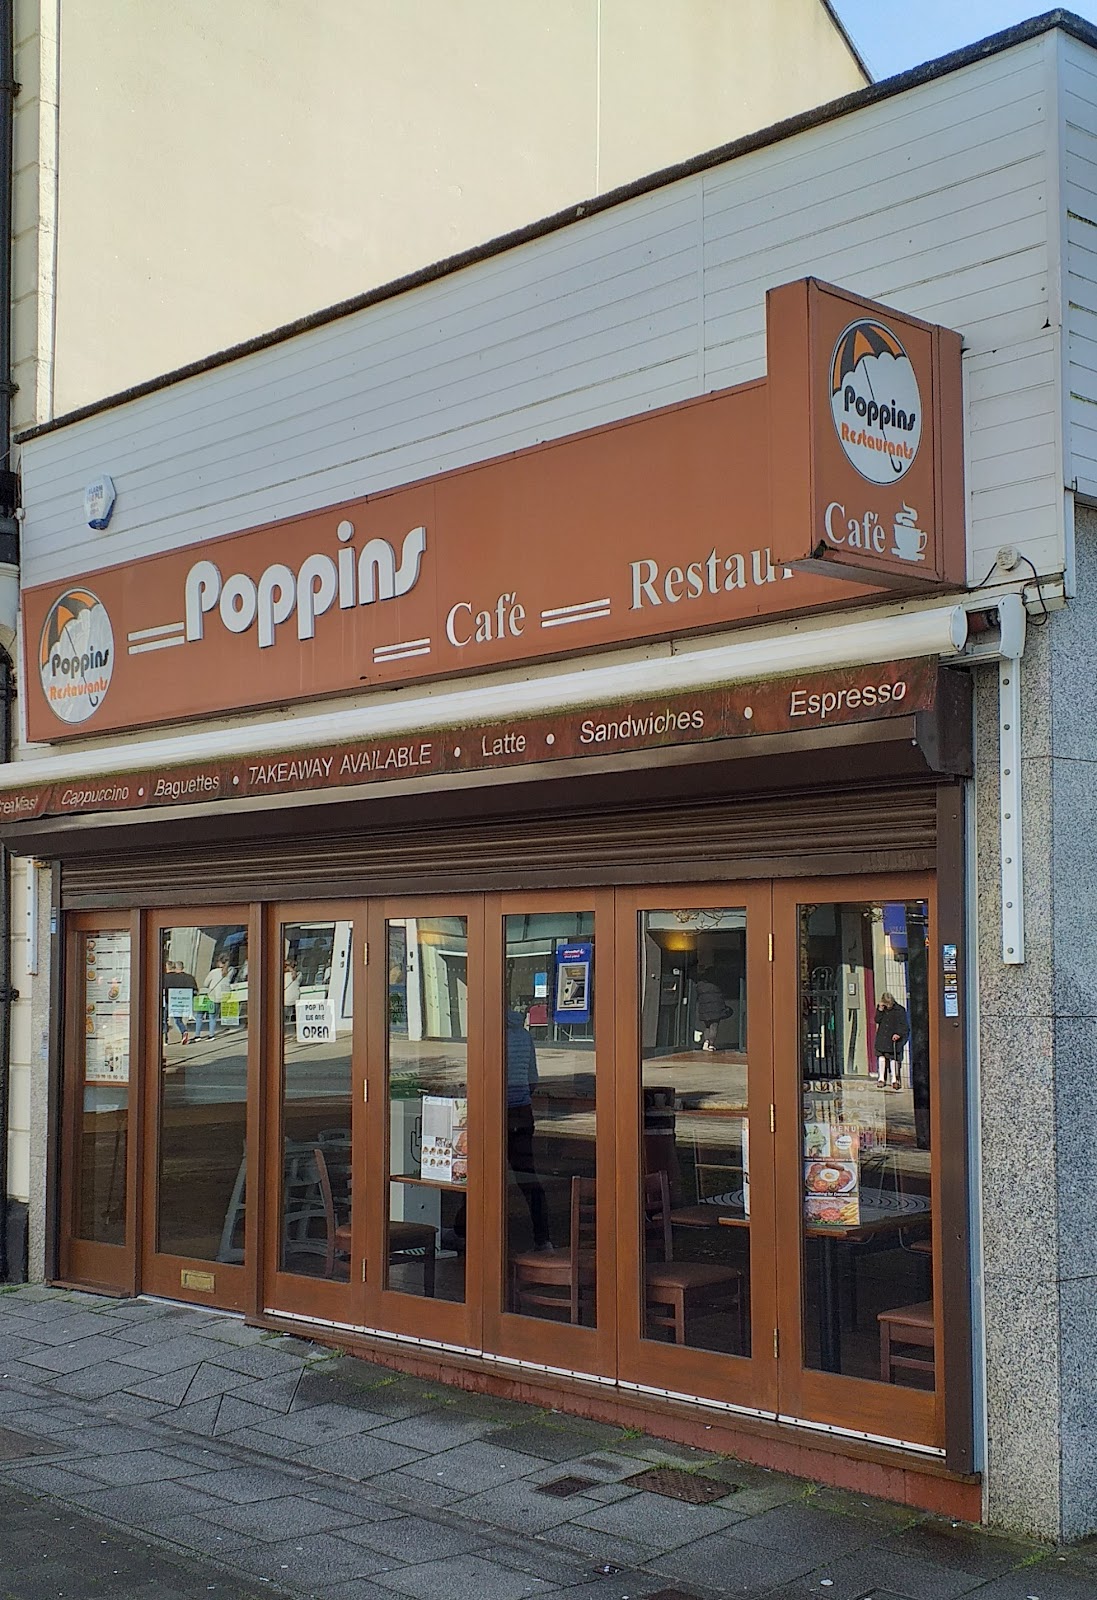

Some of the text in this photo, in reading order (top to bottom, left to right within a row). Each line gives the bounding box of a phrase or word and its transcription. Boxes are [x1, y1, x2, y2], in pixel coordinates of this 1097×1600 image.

[845, 385, 916, 431] Poppins
[841, 422, 913, 460] Restaurants
[825, 501, 886, 553] Café
[184, 520, 427, 648] Poppins
[446, 592, 526, 647] Café
[51, 645, 109, 679] Poppins
[49, 677, 108, 701] Restaurants
[61, 785, 129, 806] Cappuccino
[154, 775, 220, 799] Baguettes
[249, 757, 333, 785] TAKEAWAY
[340, 743, 432, 775] AVAILABLE
[482, 732, 526, 757] Latte
[579, 708, 704, 744] Sandwiches
[790, 681, 907, 719] Espresso
[302, 1025, 329, 1039] OPEN
[831, 1125, 856, 1133] MENU
